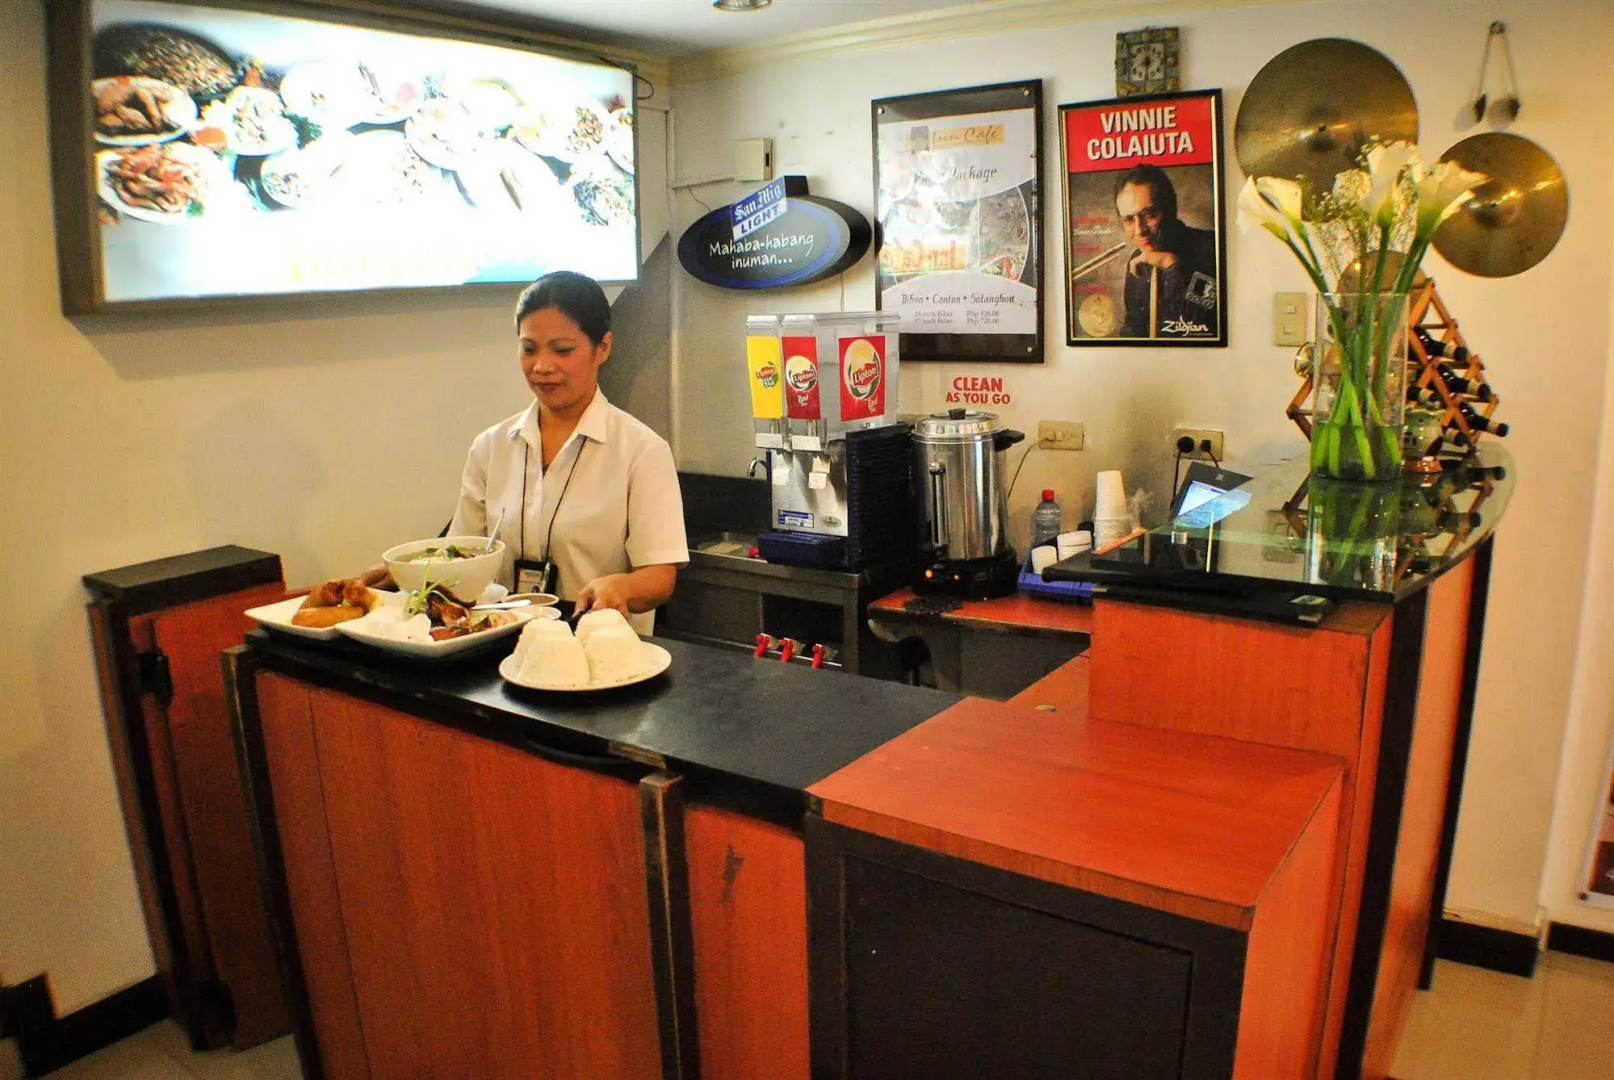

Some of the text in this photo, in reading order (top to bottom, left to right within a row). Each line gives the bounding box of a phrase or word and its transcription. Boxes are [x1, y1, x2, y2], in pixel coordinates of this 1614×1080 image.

[1100, 106, 1177, 133] VINNIE
[964, 125, 999, 144] Café
[1086, 131, 1194, 161] COLAIUTA
[734, 183, 782, 220] San Mig
[741, 204, 780, 234] LIGHT
[709, 233, 814, 257] Mahaba-habang
[731, 255, 793, 269] inuman...
[932, 293, 961, 304] Canton
[971, 292, 1015, 305] Sotanghon
[1160, 314, 1208, 337] Zildjian
[794, 372, 814, 383] Lipton
[855, 367, 877, 383] Lipton
[953, 377, 1003, 392] CLEAN
[945, 392, 1010, 404] AS YOU GO
